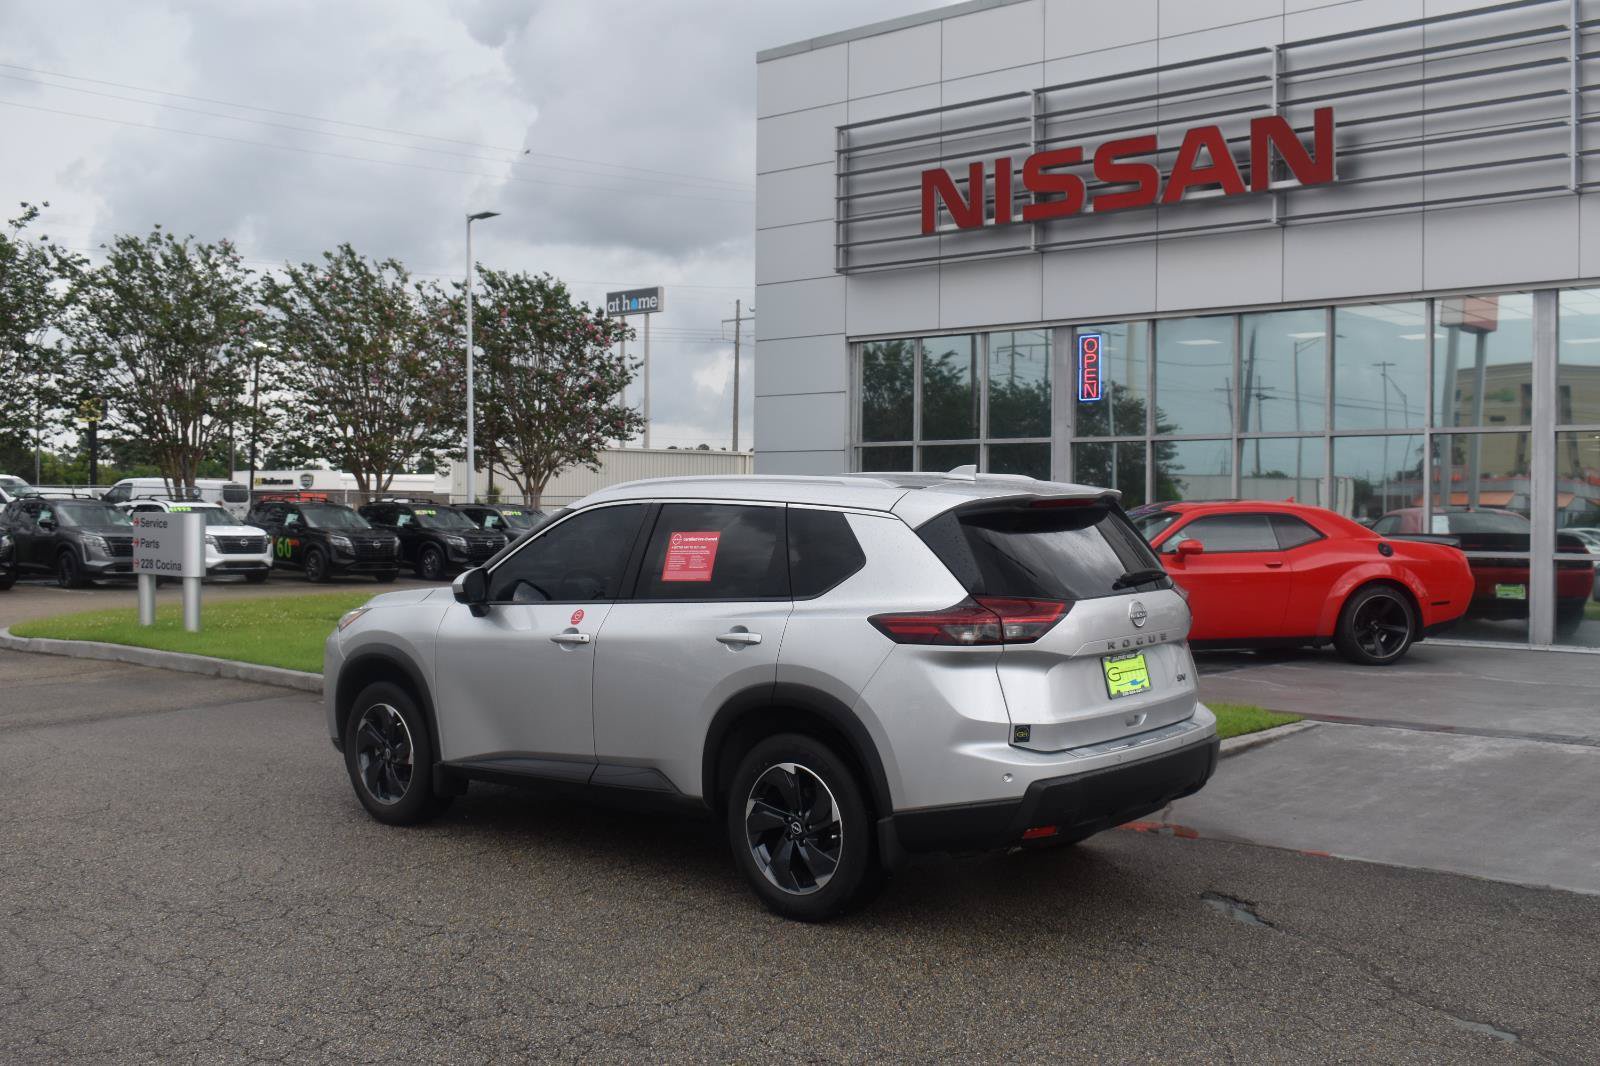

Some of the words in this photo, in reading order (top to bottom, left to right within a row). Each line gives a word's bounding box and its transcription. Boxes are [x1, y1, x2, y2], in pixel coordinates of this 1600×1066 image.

[922, 106, 1336, 235] NISSAN
[608, 297, 619, 312] at
[622, 294, 658, 311] home
[1083, 338, 1098, 398] OPEN
[140, 517, 168, 529] Service
[141, 537, 160, 549] Parts
[140, 558, 154, 569] 228
[1107, 632, 1168, 650] ROGUE
